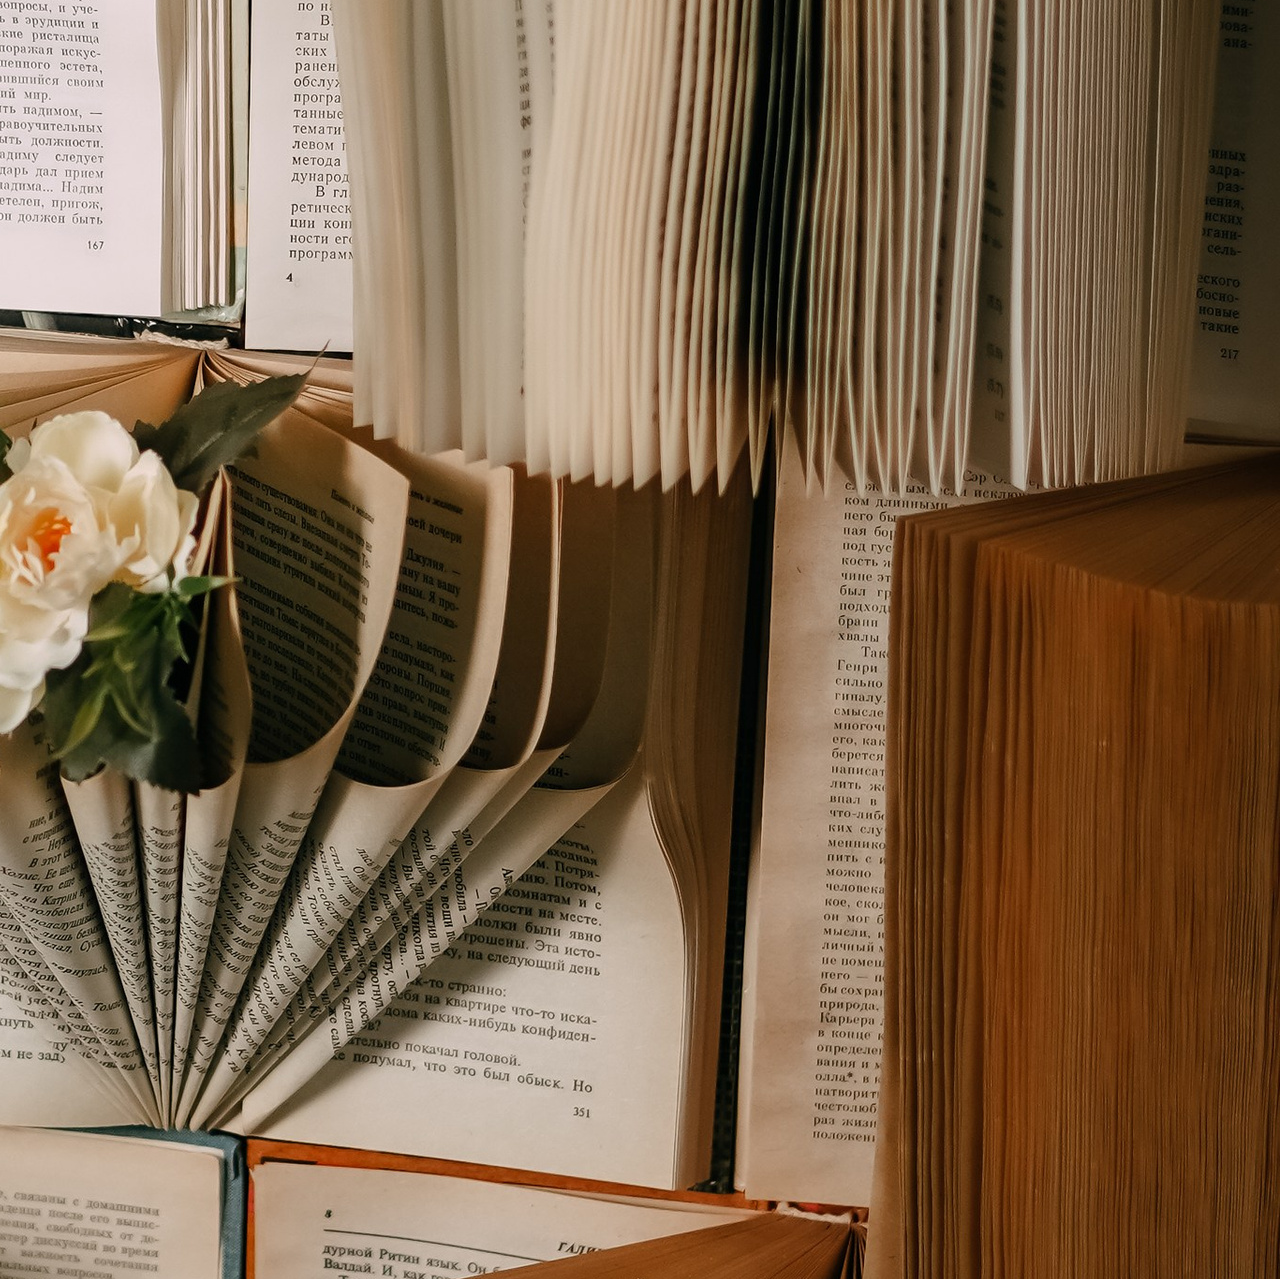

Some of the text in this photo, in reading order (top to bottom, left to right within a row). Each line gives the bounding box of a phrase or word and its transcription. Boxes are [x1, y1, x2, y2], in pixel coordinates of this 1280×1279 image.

[32, 32, 99, 45] ристалища
[24, 91, 51, 103] мир.
[292, 156, 340, 167] метода
[17, 214, 65, 223] должен
[72, 213, 103, 225] быть
[88, 240, 104, 250] 167
[286, 273, 292, 282] 4
[1220, 348, 1240, 359] 217
[838, 633, 879, 642] хвалы
[838, 659, 877, 675] Генри
[826, 868, 871, 878] можно
[525, 922, 561, 937] были
[487, 953, 565, 971] следующий
[448, 982, 506, 997] странно:
[385, 1006, 596, 1042] дома каких-нибудь конфиден-
[405, 1043, 521, 1066] покачал головой.
[353, 1053, 592, 1093] подумал, что это был обыск. Но
[573, 1107, 590, 1118] 351
[322, 1245, 461, 1271] дурной Ритин язык.
[323, 1258, 375, 1274] Валдай.
[382, 1265, 397, 1279] И,
